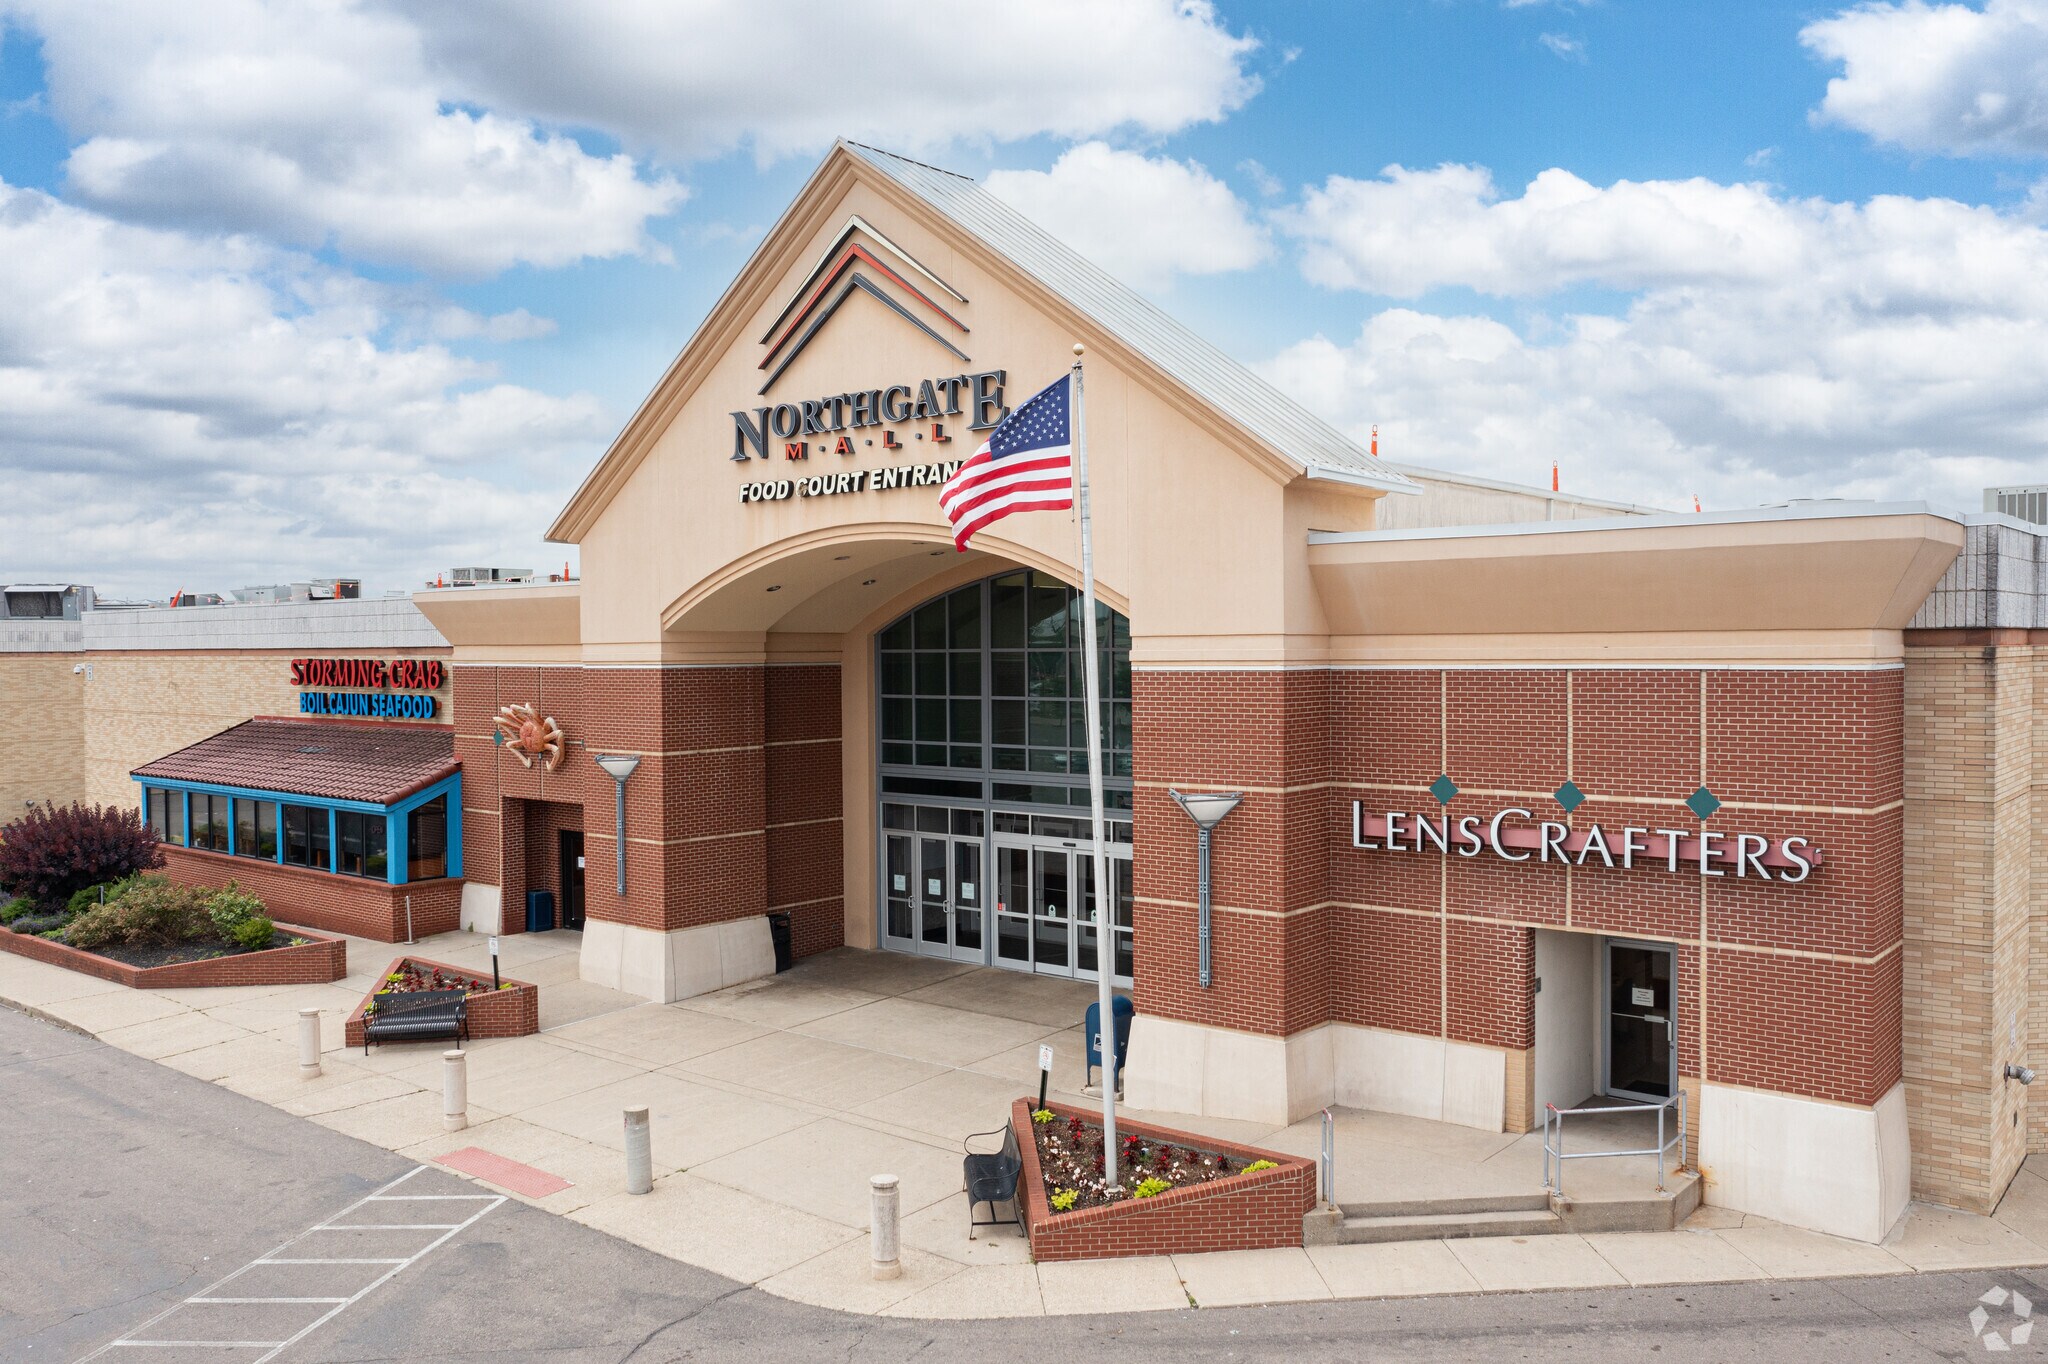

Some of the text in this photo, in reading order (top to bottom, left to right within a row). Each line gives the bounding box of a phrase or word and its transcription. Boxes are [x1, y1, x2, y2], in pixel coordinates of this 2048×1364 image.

[729, 369, 1009, 461] NORTHGATE
[738, 460, 967, 503] FOOD COURT ENTRAN
[290, 659, 441, 690] STORMING CRAB
[300, 692, 434, 719] BOIL CAJUN SEAFOOD
[1352, 799, 1812, 883] LENSCRAFTERS
